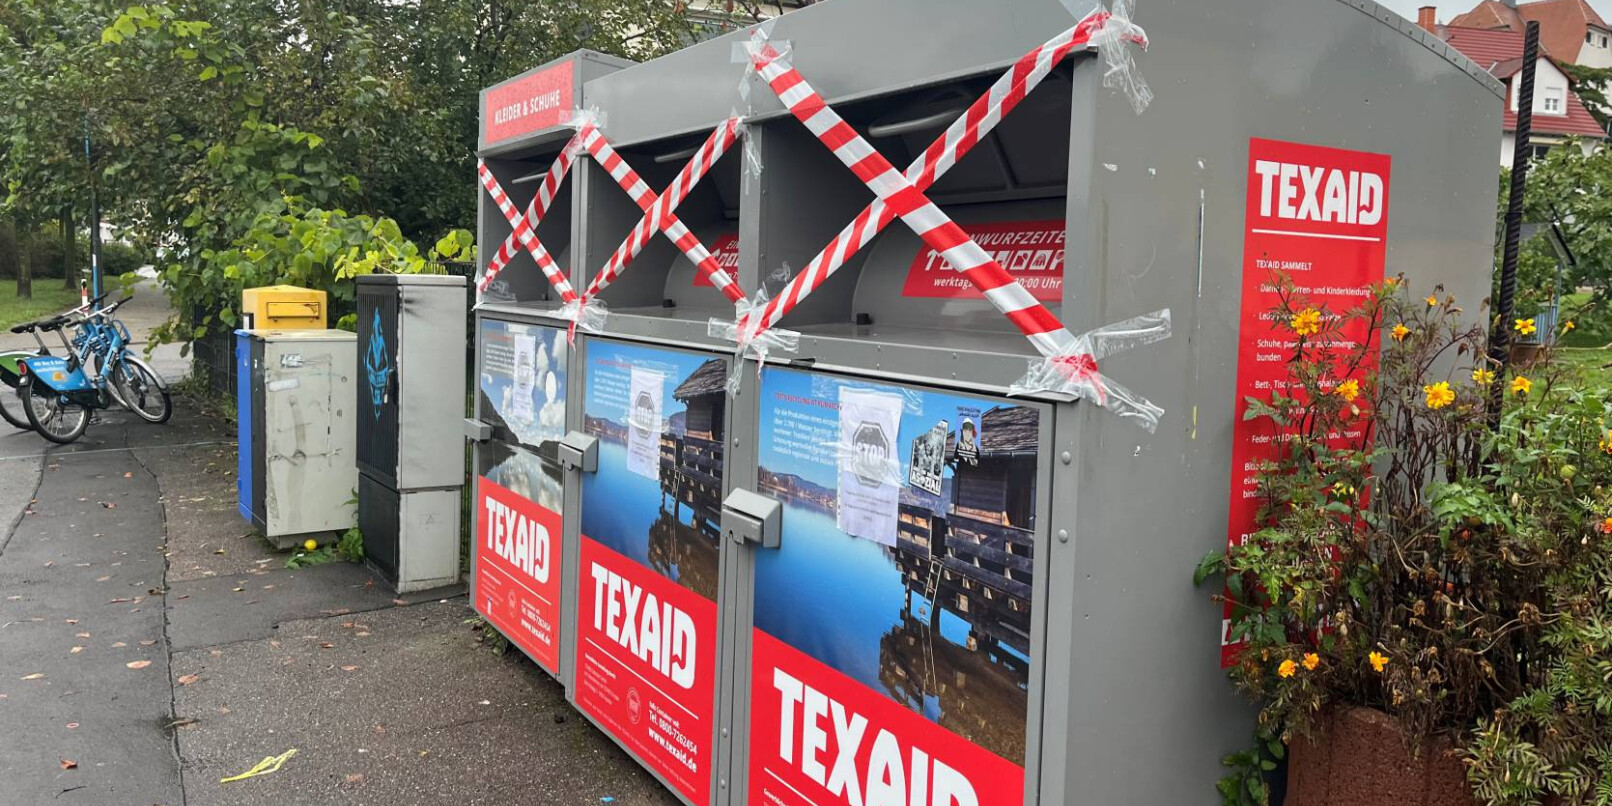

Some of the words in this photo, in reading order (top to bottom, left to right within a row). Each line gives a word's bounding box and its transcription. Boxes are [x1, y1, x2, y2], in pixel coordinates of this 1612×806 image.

[494, 102, 521, 126] KLEIDER
[523, 100, 528, 117] &
[530, 89, 560, 115] SCHUHE
[1255, 160, 1384, 225] TEXAID
[1256, 259, 1280, 269] TEXAID
[1281, 261, 1312, 271] SAMMELT
[934, 276, 973, 290] werktags
[1041, 278, 1062, 289] Uhr
[1313, 286, 1326, 295] und
[1326, 287, 1371, 298] Kinderkleidung
[1257, 339, 1283, 349] Schuhe,
[1256, 353, 1282, 361] bunden
[1252, 435, 1271, 443] Feder-
[856, 442, 886, 466] STOP
[485, 495, 551, 584] TEXAID
[591, 561, 697, 689] TEXAID
[649, 709, 658, 726] Tel.
[659, 717, 697, 756] 0800-7262454
[648, 726, 697, 774] www.texaid.de
